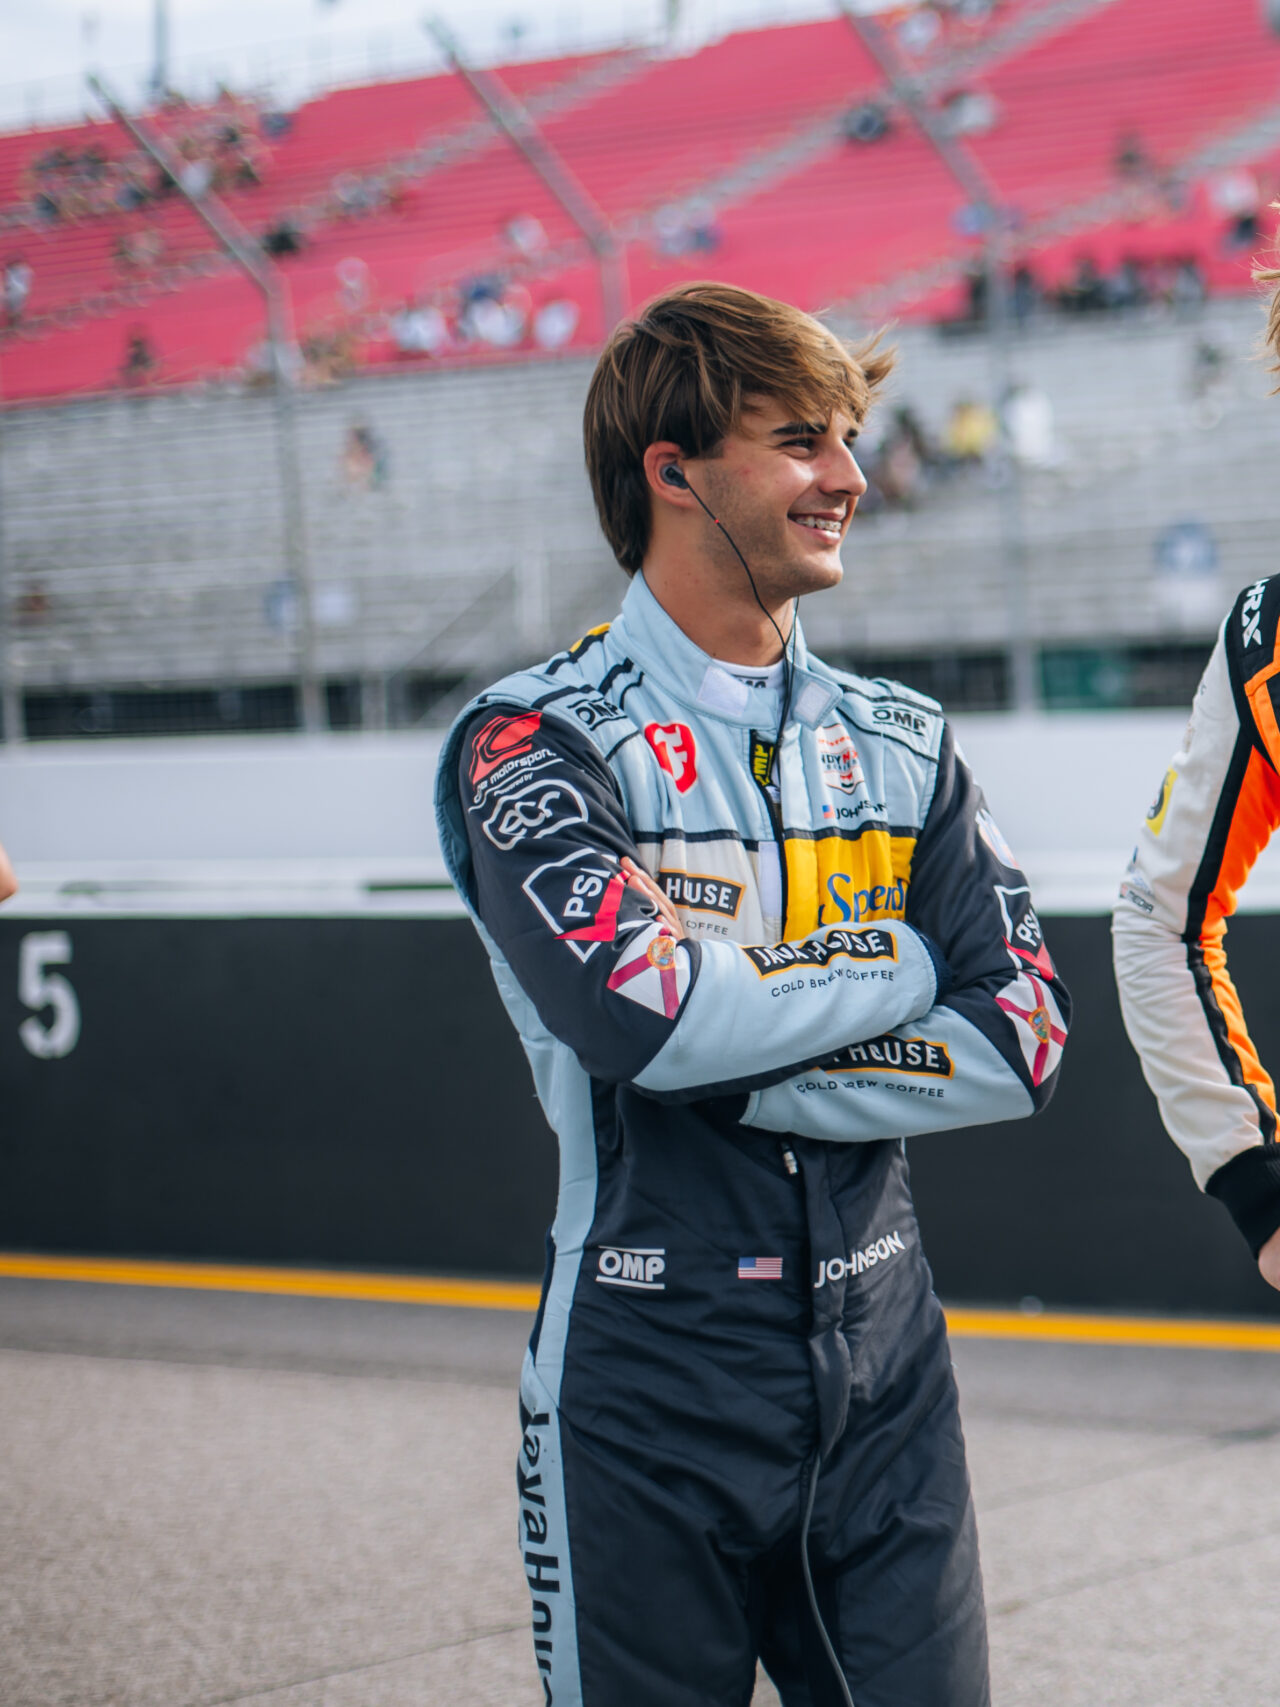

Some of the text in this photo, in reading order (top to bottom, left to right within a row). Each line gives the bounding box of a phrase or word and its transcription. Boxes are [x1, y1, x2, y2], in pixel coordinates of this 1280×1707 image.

[1241, 578, 1271, 648] HRX
[872, 709, 927, 730] OMP
[18, 929, 82, 1060] 5
[771, 968, 895, 998] COLD BREW COFFEE
[796, 1080, 838, 1094] COLD
[885, 1081, 945, 1098] COFFEE
[599, 1249, 665, 1282] OMP
[813, 1230, 906, 1289] JOHNSON
